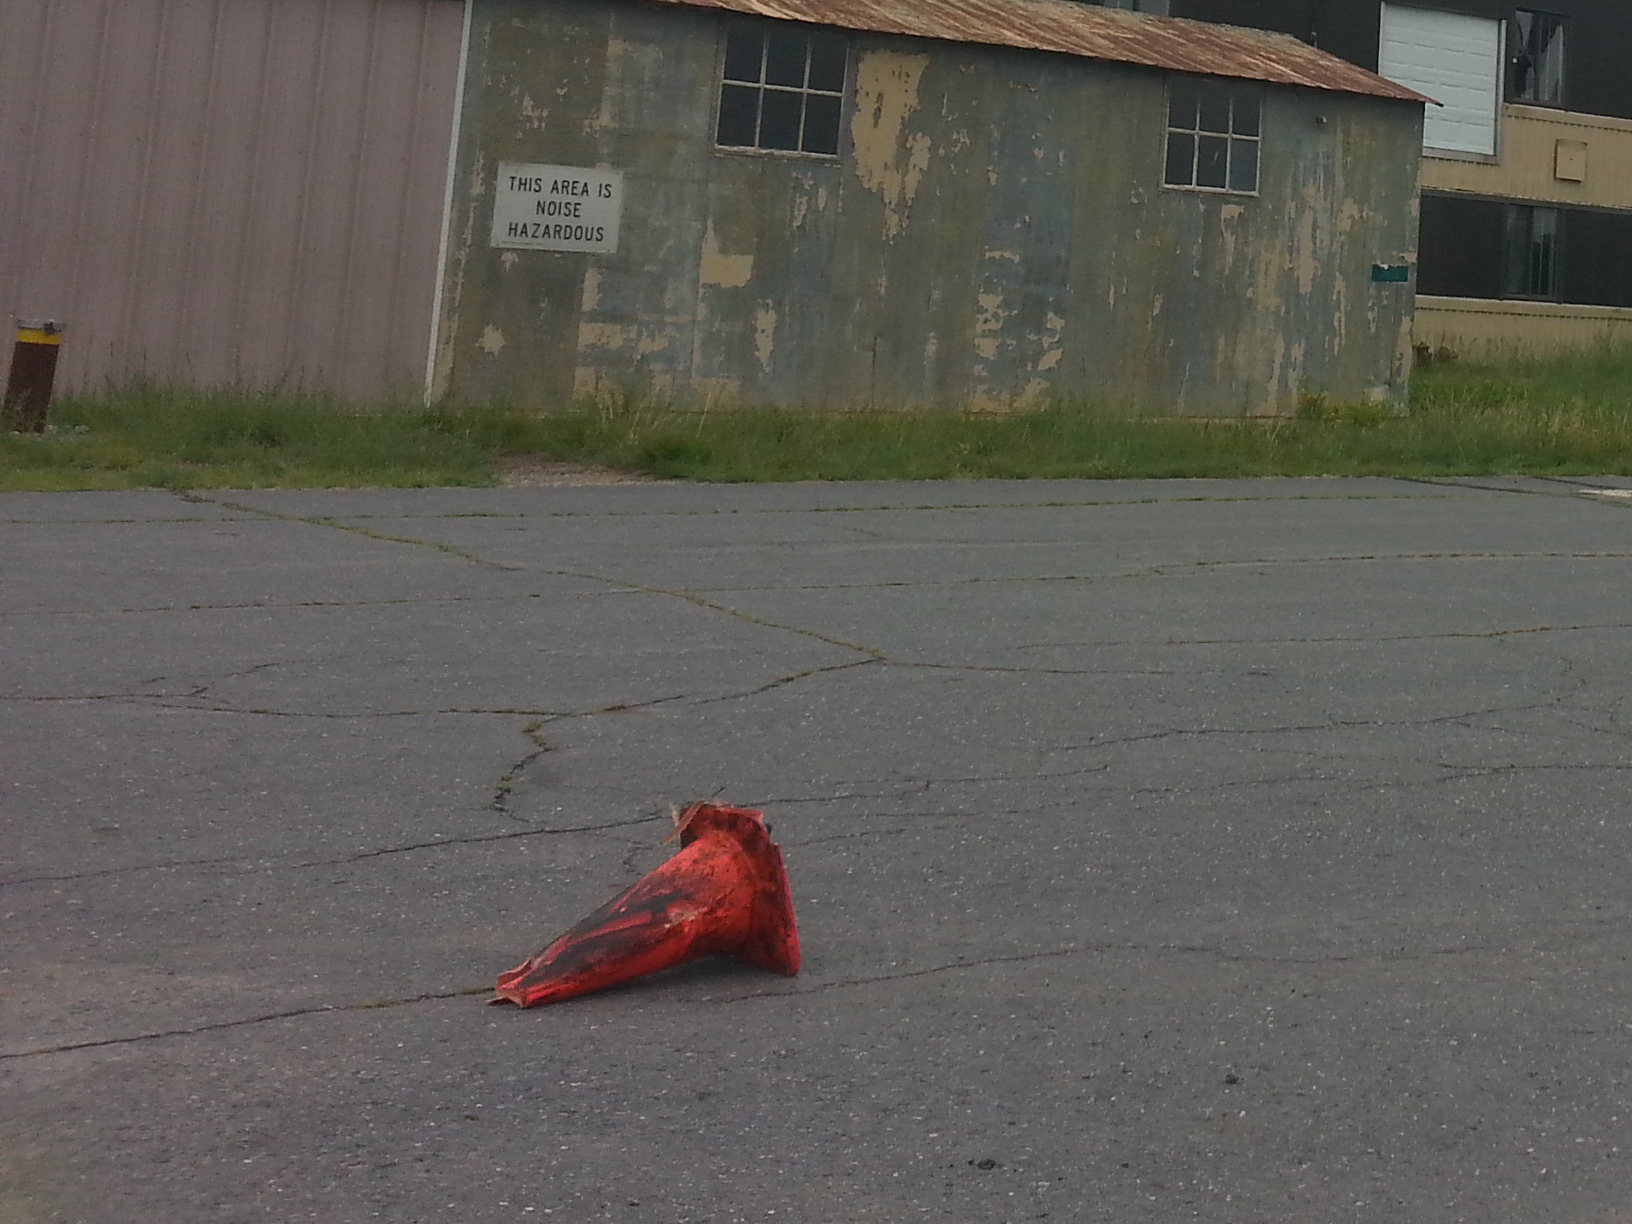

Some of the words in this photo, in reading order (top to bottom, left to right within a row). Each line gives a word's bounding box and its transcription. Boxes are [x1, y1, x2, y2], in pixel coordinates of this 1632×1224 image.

[509, 176, 542, 193] THIS
[550, 179, 589, 197] AREA
[598, 183, 612, 198] IS
[536, 200, 582, 218] NOISE
[508, 222, 604, 242] HAZARDOUS
